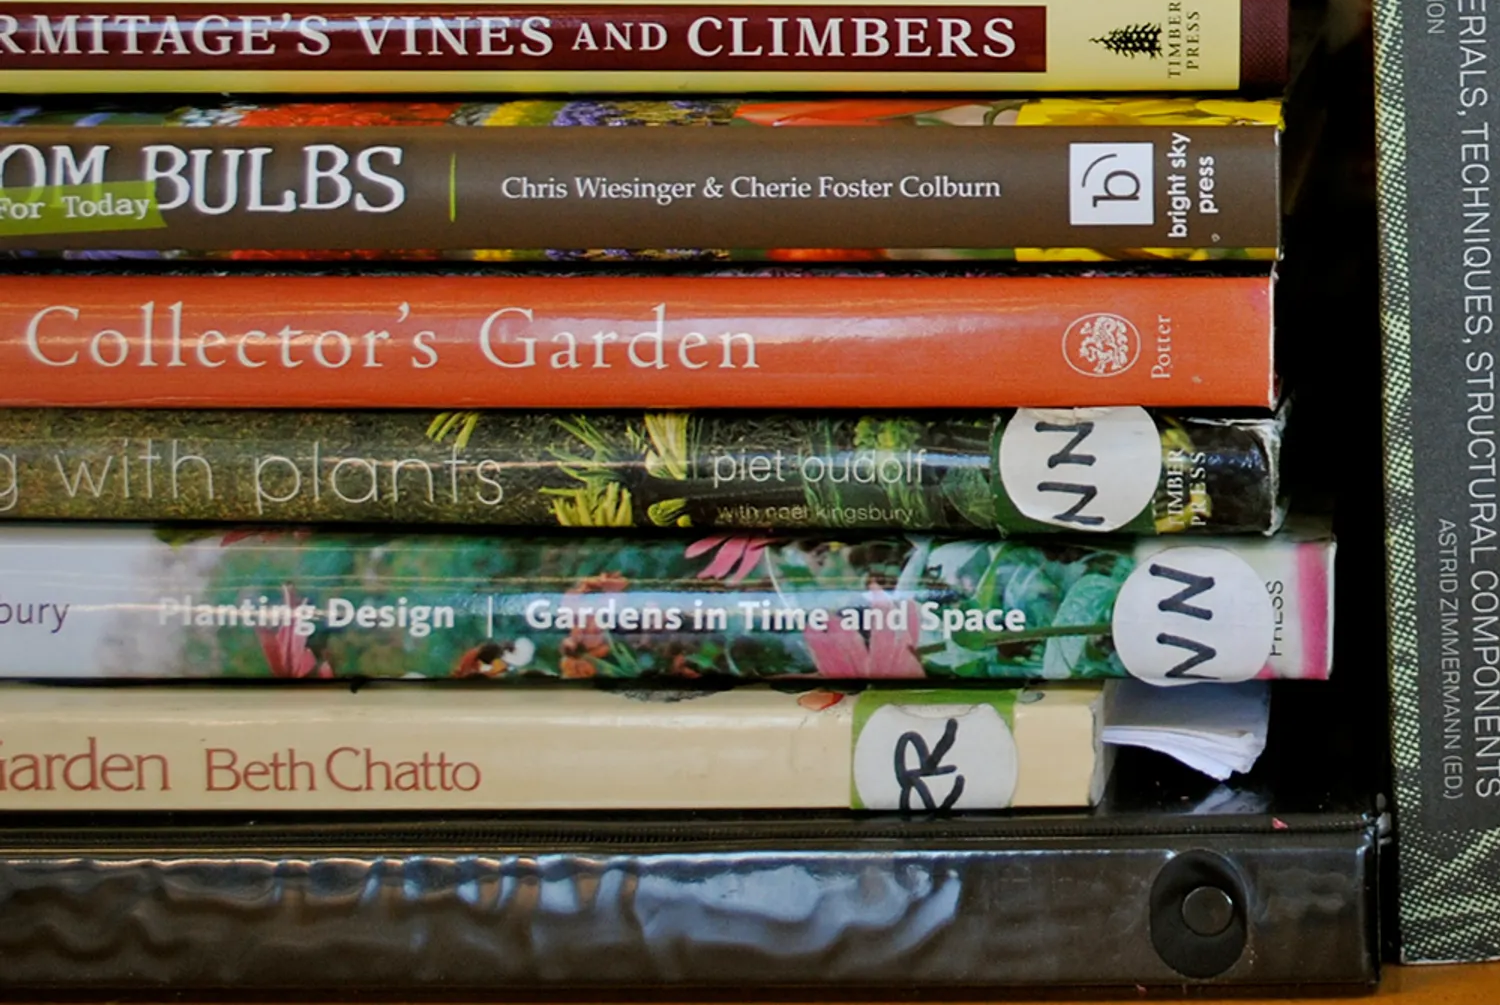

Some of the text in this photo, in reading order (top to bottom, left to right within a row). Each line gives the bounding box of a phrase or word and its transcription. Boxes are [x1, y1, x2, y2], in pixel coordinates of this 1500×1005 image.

[348, 16, 553, 56] VINES
[572, 22, 667, 51] AND
[688, 17, 1016, 57] CLIMBERS
[1168, 1, 1181, 79] TIMBER
[1186, 9, 1200, 70] PRESS
[62, 193, 150, 220] Today
[142, 145, 404, 215] BULBS
[502, 176, 1001, 207] Chris Wiesinger & Cherie Foster Colburn
[1168, 132, 1191, 238] bright sky
[1198, 155, 1219, 214] press
[1459, 122, 1493, 343] TECHNIQUES,
[26, 302, 759, 369] Collector's Garden
[1151, 314, 1172, 380] Potter
[55, 439, 214, 498] with
[255, 441, 503, 513] plants
[714, 449, 927, 488] piet oudolf
[1167, 449, 1186, 525] TIMBER
[1190, 451, 1207, 526] PRESS
[1465, 352, 1498, 559] STRUCTURAL
[718, 504, 759, 521] with
[816, 504, 914, 522] kingsbury
[159, 596, 455, 638] Planting Design
[525, 599, 1026, 641] Gardens in Time and Space
[1438, 518, 1464, 801] ASTRID ZIMMERMANN (ED.)
[0, 737, 481, 792] arden Beth Chatto
